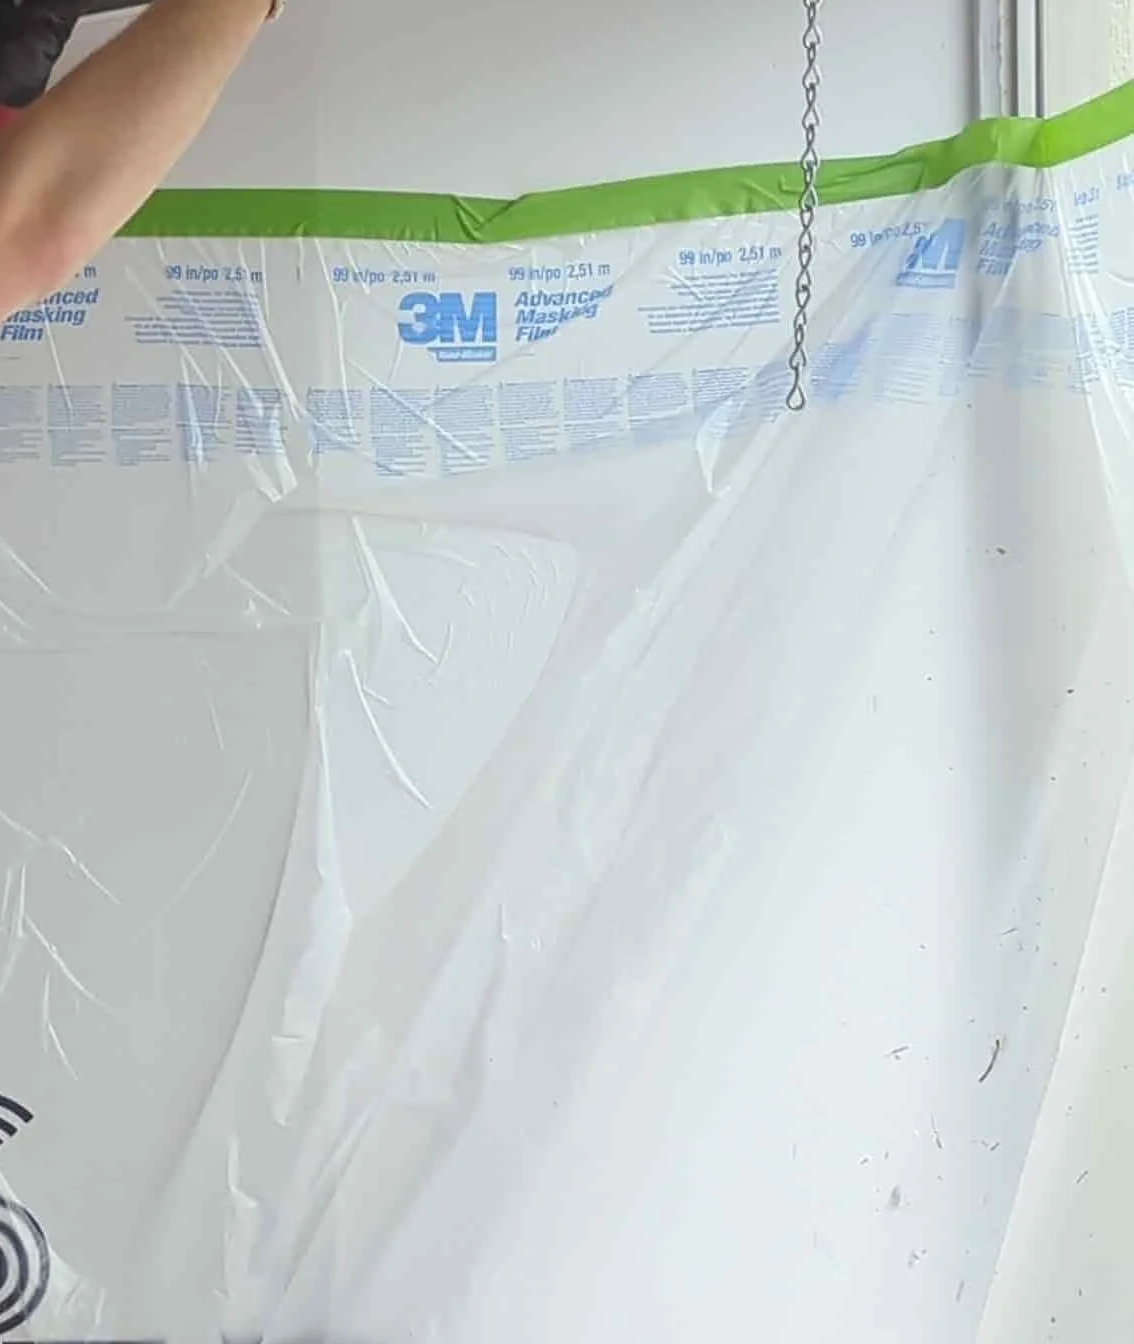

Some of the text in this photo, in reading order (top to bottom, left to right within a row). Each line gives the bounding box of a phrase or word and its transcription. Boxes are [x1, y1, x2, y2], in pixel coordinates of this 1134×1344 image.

[678, 249, 697, 266] 99
[332, 267, 349, 283] 99
[508, 267, 526, 282] 99
[568, 263, 594, 280] 2,51
[598, 263, 611, 276] m
[515, 284, 615, 308] Advanced
[398, 291, 498, 344] 3M
[515, 303, 599, 325] Masking
[0, 324, 43, 341] Film
